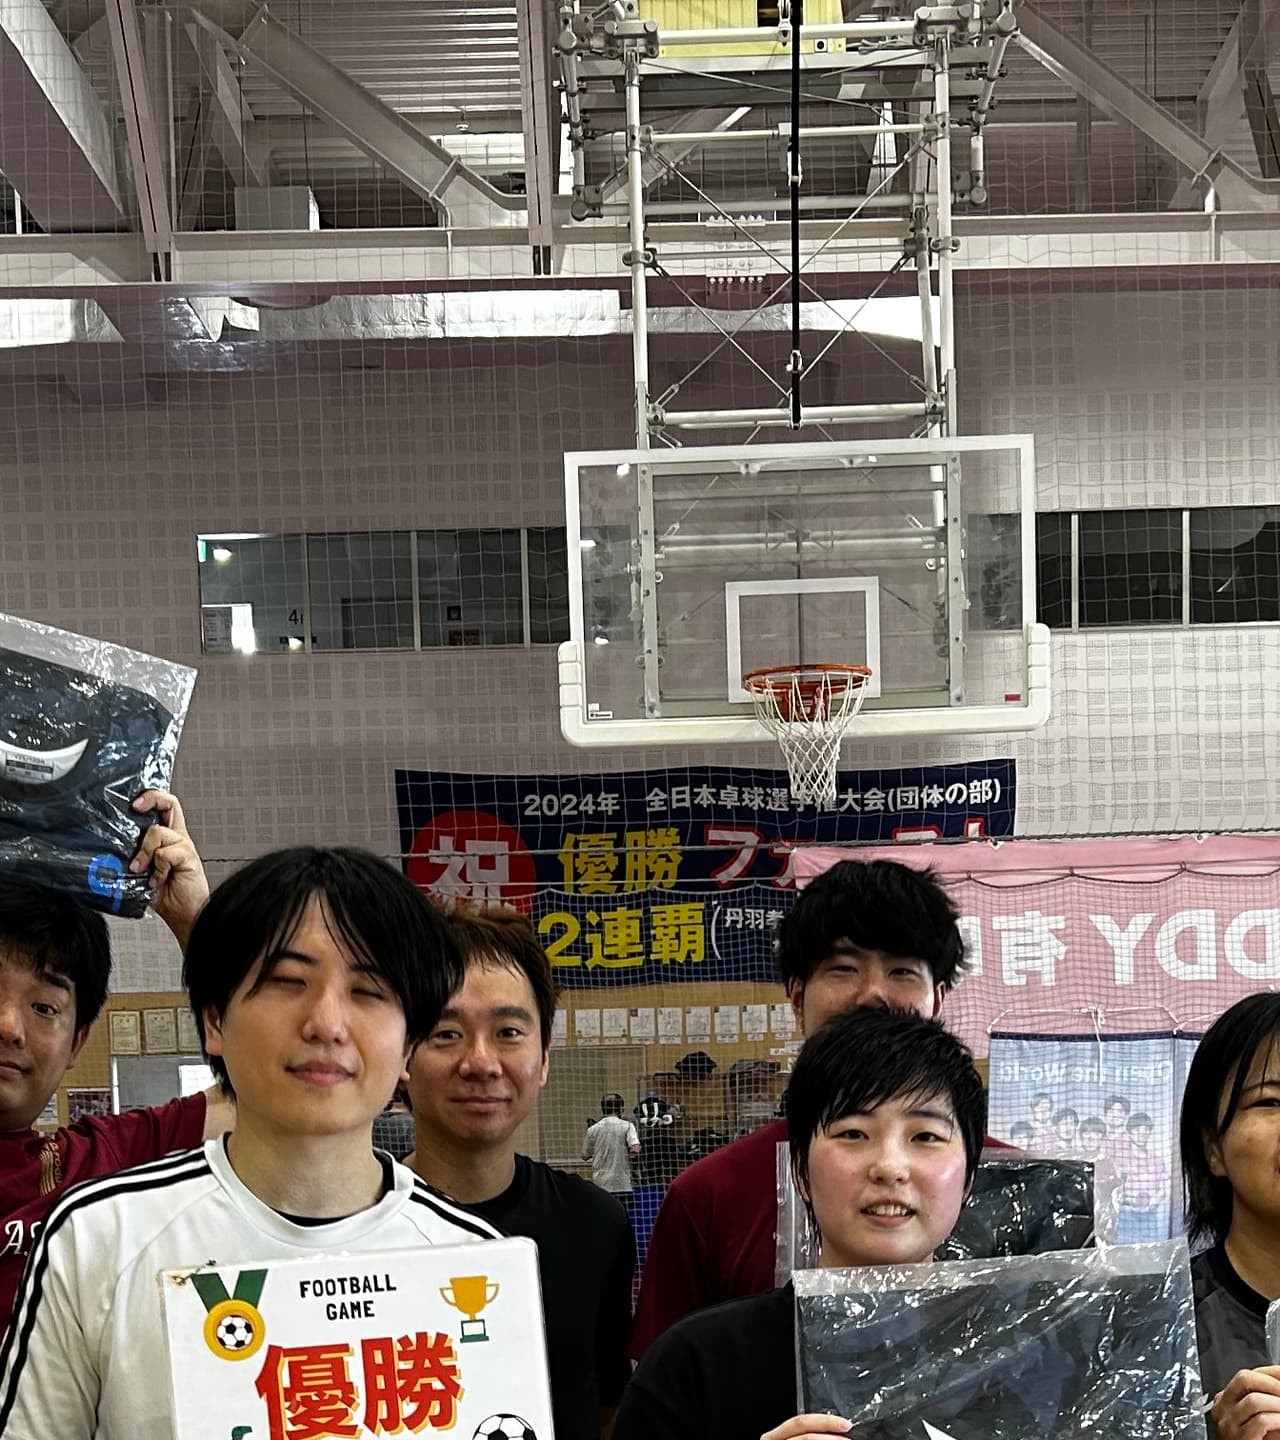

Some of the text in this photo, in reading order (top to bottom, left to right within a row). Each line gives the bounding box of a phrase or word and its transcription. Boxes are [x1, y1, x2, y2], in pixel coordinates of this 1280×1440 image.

[523, 792, 621, 816] 2024年
[428, 836, 516, 916] 祝
[558, 827, 683, 894] 優勝
[537, 902, 705, 971] 2連覇
[299, 1274, 397, 1298] FOOTBALL
[326, 1301, 375, 1321] GAME
